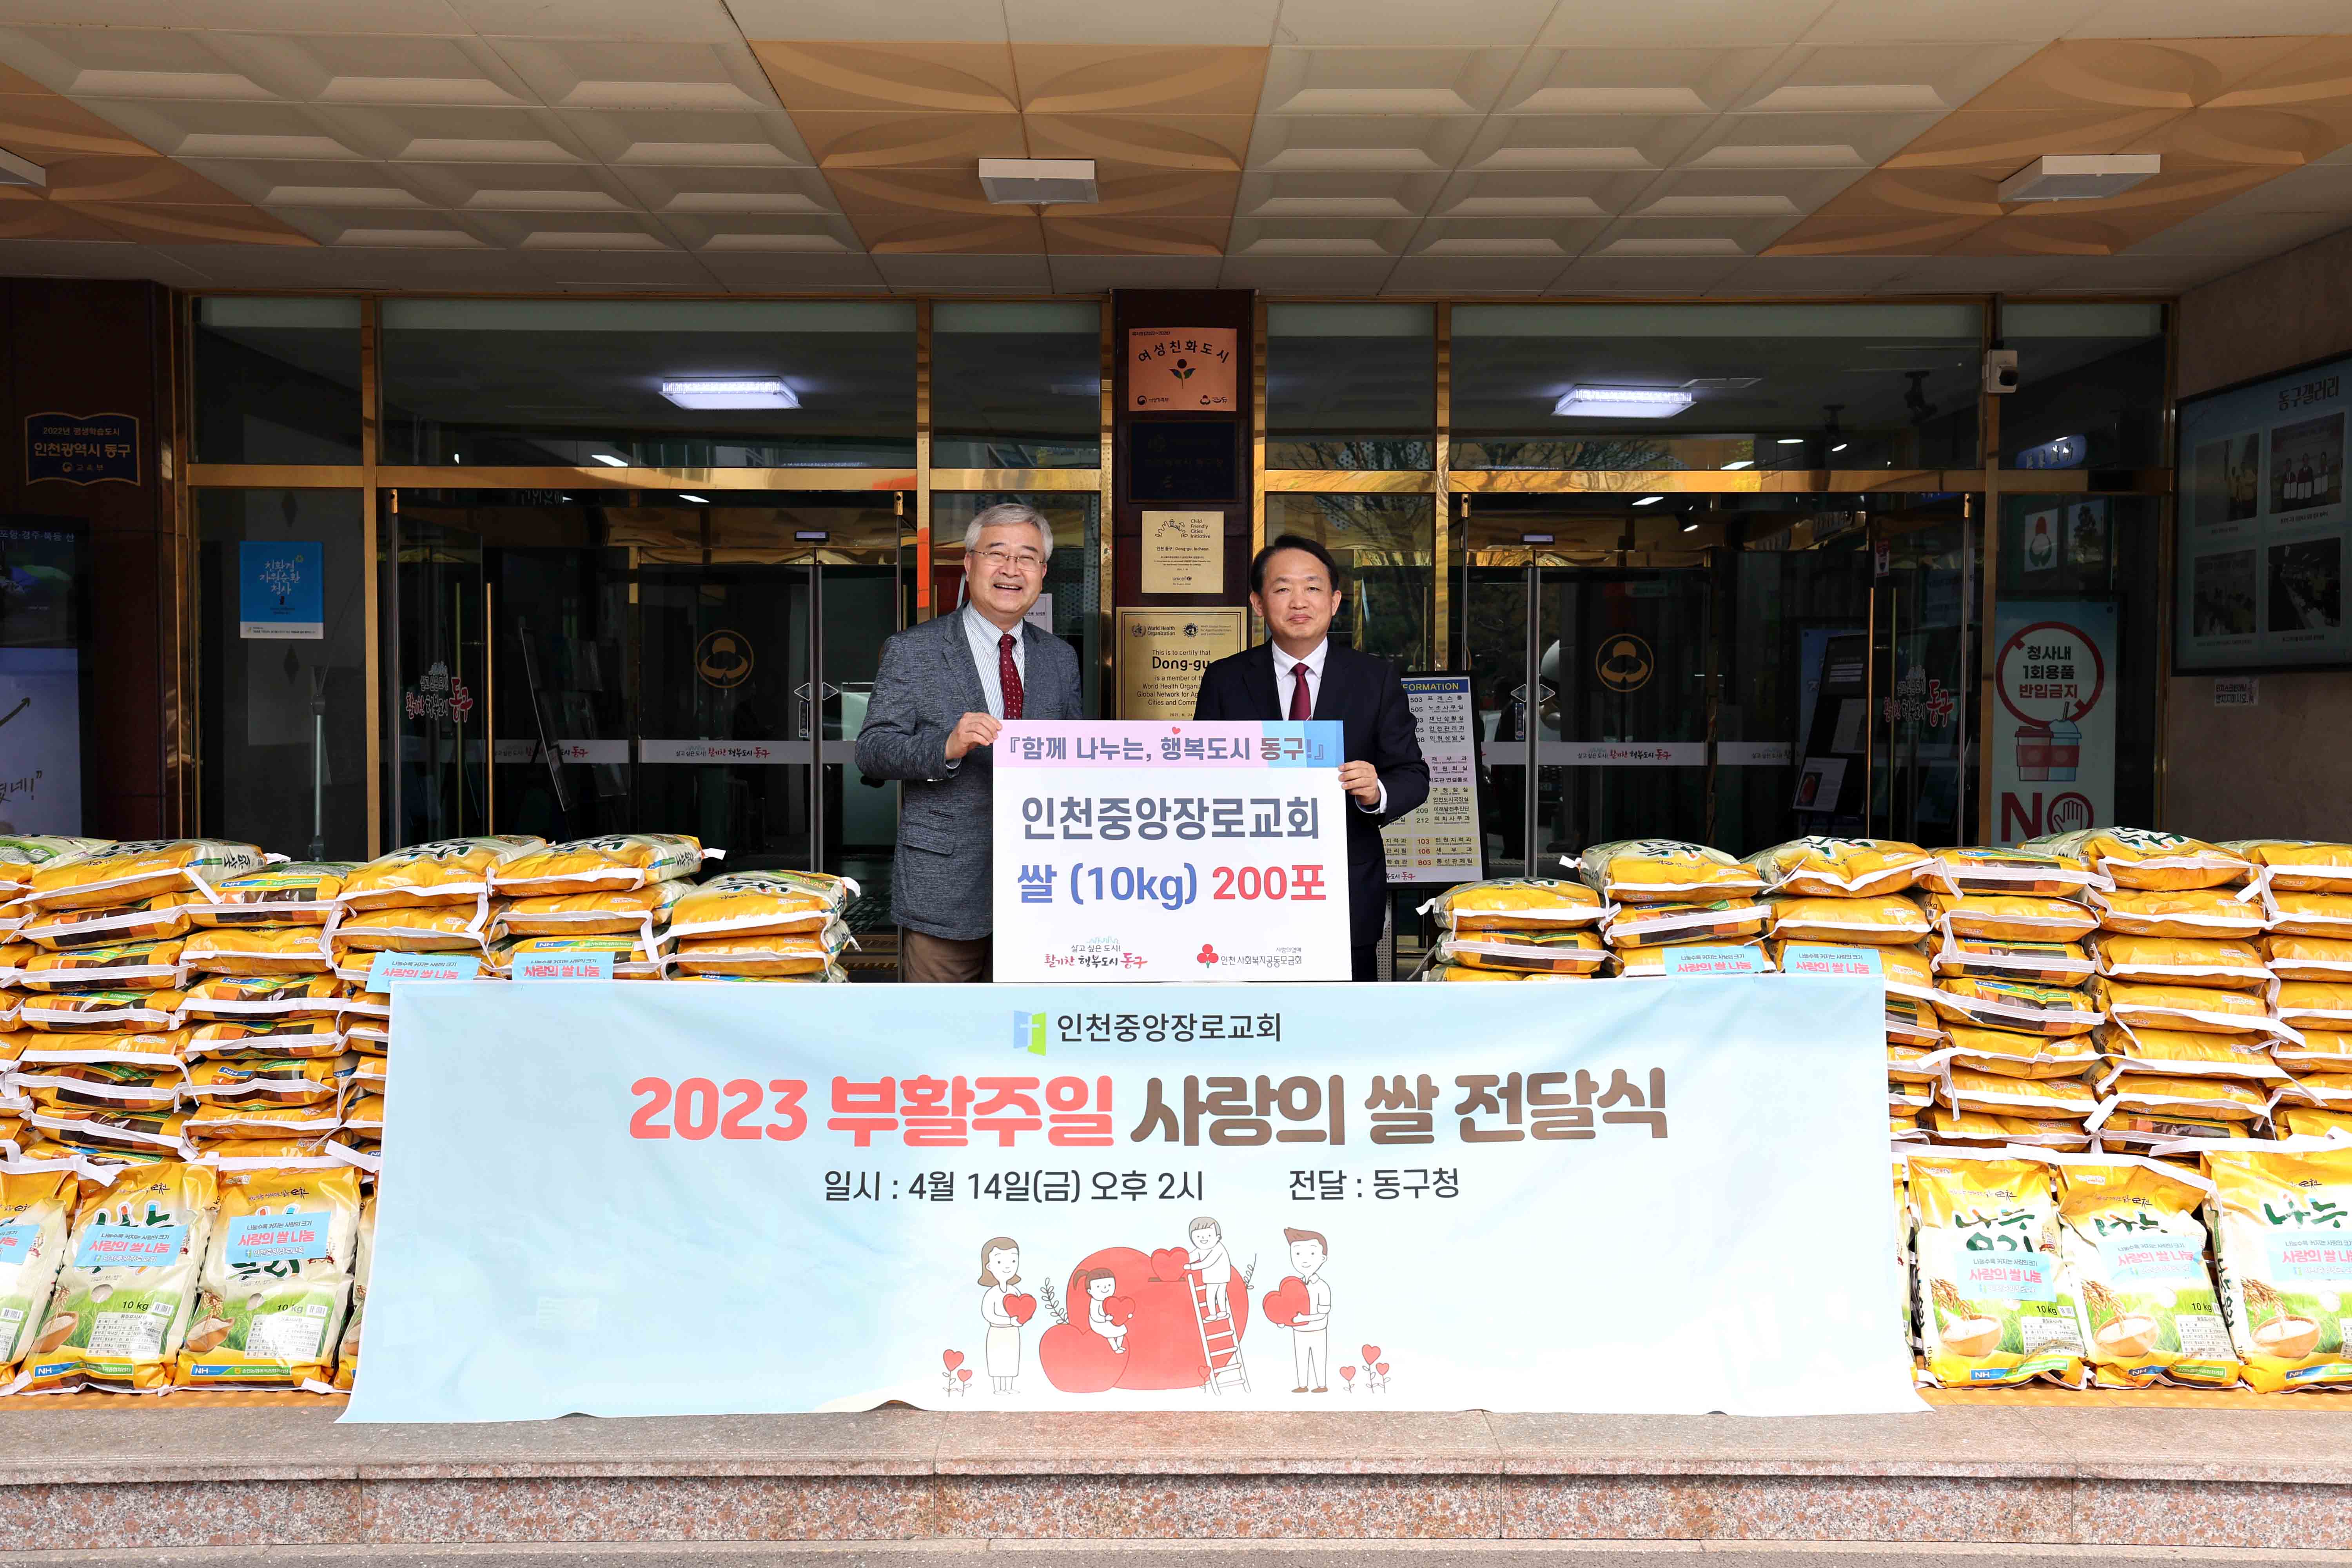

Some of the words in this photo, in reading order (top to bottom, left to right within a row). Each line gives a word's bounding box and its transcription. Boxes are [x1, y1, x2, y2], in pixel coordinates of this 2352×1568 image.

[1138, 339, 1229, 363] 여성친화도시
[44, 426, 69, 436] 2022년
[34, 442, 101, 458] 인천광역시
[104, 443, 132, 458] 동구
[2026, 645, 2071, 661] 청사내
[1152, 656, 1210, 671] Dong-gu
[2022, 664, 2075, 681] 1회용품
[1402, 682, 1459, 691] FORMATION
[2019, 684, 2078, 700] 반입금지
[449, 677, 473, 723] 동구
[1926, 679, 1955, 728] 동구
[753, 747, 771, 759] 동구
[1010, 736, 1066, 760] 『함께
[1077, 737, 1152, 762] 나누는,
[1160, 736, 1250, 760] 행복도시
[1260, 737, 1324, 760] 동구!』
[1655, 749, 1672, 760] 동구
[1021, 796, 1320, 840] 인천중앙장로교회
[1017, 863, 1057, 904] 쌀
[1070, 862, 1198, 911] (10kg)
[1212, 864, 1327, 901] 200포
[1071, 944, 1085, 953] 살고
[1087, 944, 1102, 953] 싶은
[1103, 944, 1121, 952] 도시!
[1044, 953, 1075, 968] 활기찬
[1078, 954, 1118, 968] 행복도시
[1120, 953, 1148, 969] 동구
[1220, 955, 1236, 966] 인천
[1237, 955, 1302, 968] 사회복지공동모금회
[1795, 961, 1829, 973] 사랑의
[1831, 962, 1844, 973] 쌀
[1846, 963, 1869, 974] 나눔
[380, 968, 419, 978] 사랑의
[420, 969, 433, 979] 쌀
[435, 970, 459, 979] 나눔
[524, 965, 559, 977] 사랑의
[561, 965, 575, 977] 쌀
[576, 965, 600, 977] 나눔
[1057, 1013, 1282, 1042] 인천중앙장로교회
[630, 1076, 809, 1142] 2023
[827, 1074, 1115, 1147] 부활주일
[1130, 1074, 1345, 1147] 사랑의
[1364, 1073, 1441, 1145] 쌀
[1454, 1067, 1668, 1144] 전달식
[824, 1170, 881, 1202] 일시
[908, 1170, 955, 1202] 4월
[967, 1169, 1081, 1203] 14일(금)
[1091, 1169, 1148, 1202] 오후
[1158, 1172, 1204, 1201] 2시
[1288, 1169, 1347, 1201] 전달
[1373, 1167, 1460, 1200] 동구청
[238, 1232, 274, 1246] 사랑의
[276, 1231, 289, 1244] 쌀
[290, 1230, 316, 1243] 나눔
[88, 1240, 129, 1252] 사랑의
[129, 1242, 145, 1252] 쌀
[144, 1243, 171, 1253] 나눔
[253, 1246, 305, 1255] 인천중앙장로교회
[2118, 1252, 2155, 1266] 사랑의
[2156, 1251, 2171, 1261] 쌀
[1969, 1267, 2007, 1281] 사랑의
[2009, 1269, 2022, 1282] 쌀
[2023, 1269, 2042, 1283] 나눔
[136, 1301, 149, 1311] kg
[2048, 1306, 2058, 1316] kg
